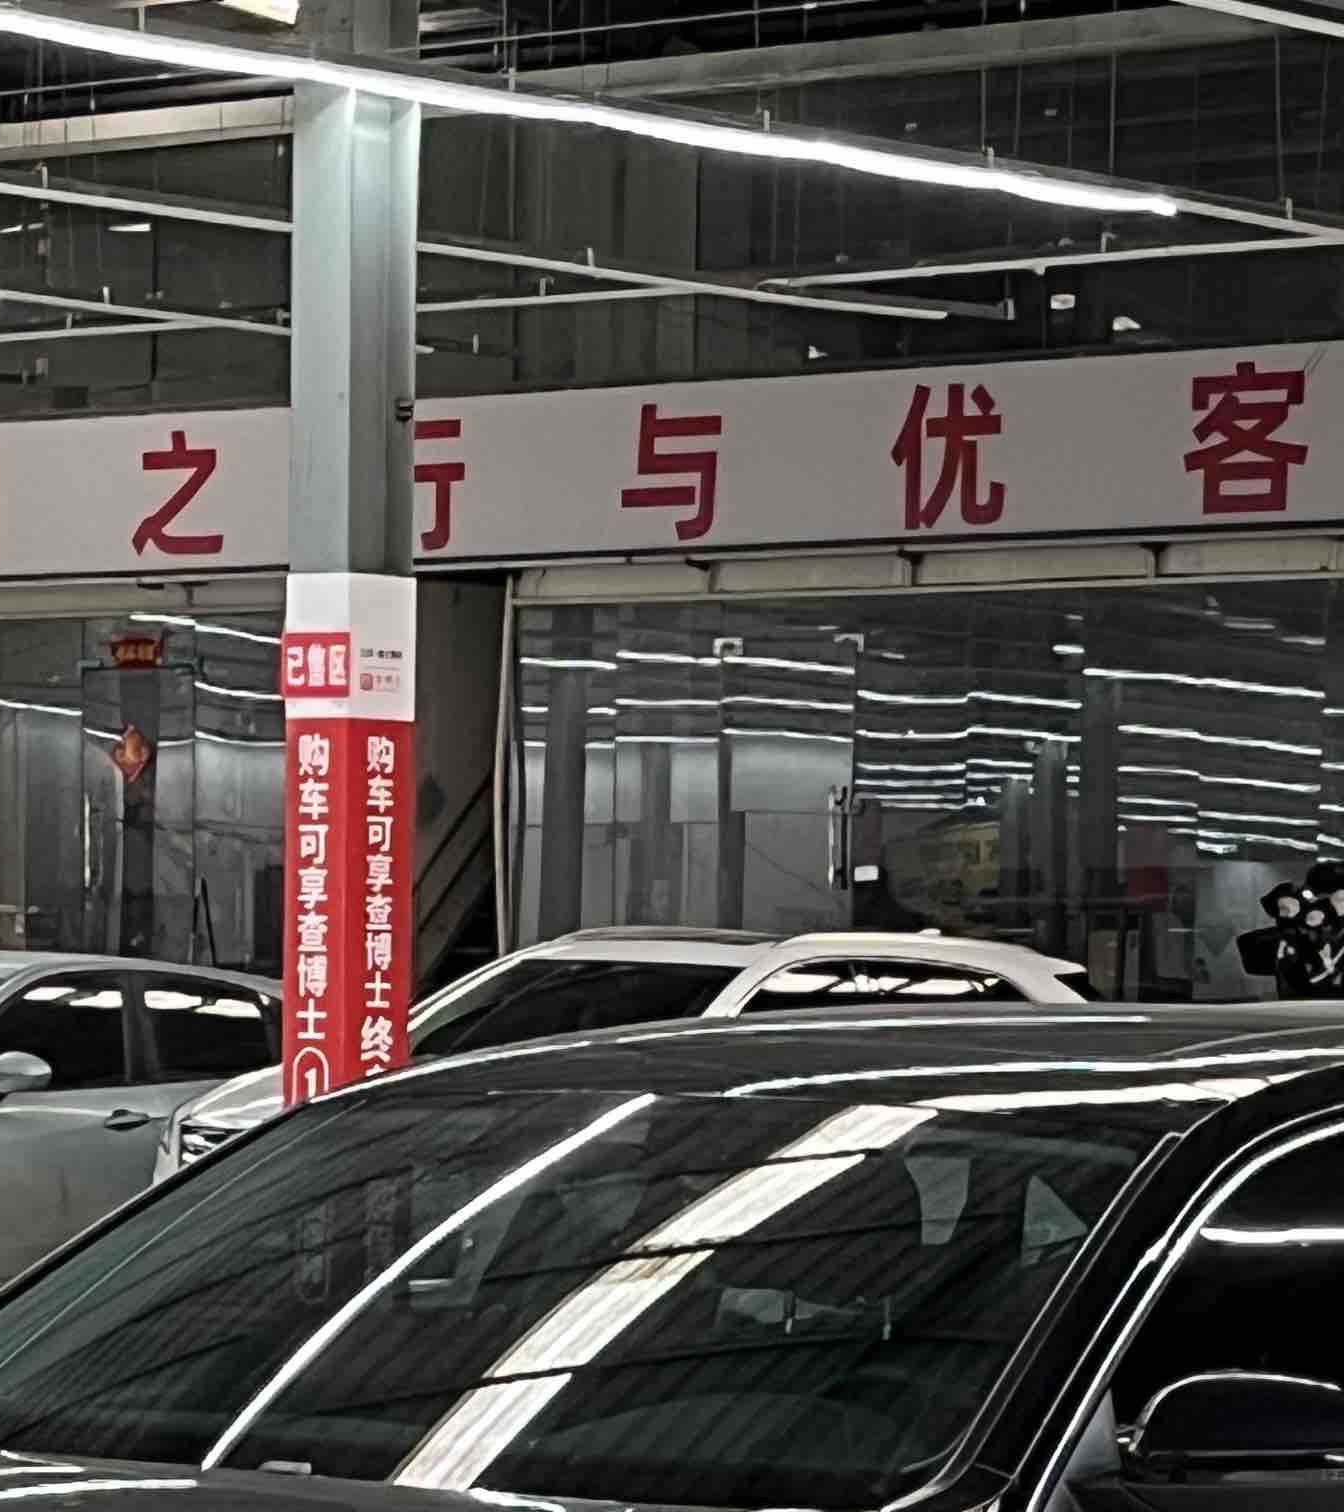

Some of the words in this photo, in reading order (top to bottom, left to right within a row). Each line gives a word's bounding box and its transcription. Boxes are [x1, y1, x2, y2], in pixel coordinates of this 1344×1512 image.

[287, 643, 347, 687] 已售区
[295, 733, 330, 1040] 购车可享查博士
[360, 736, 394, 1077] 购车可享查博士终
